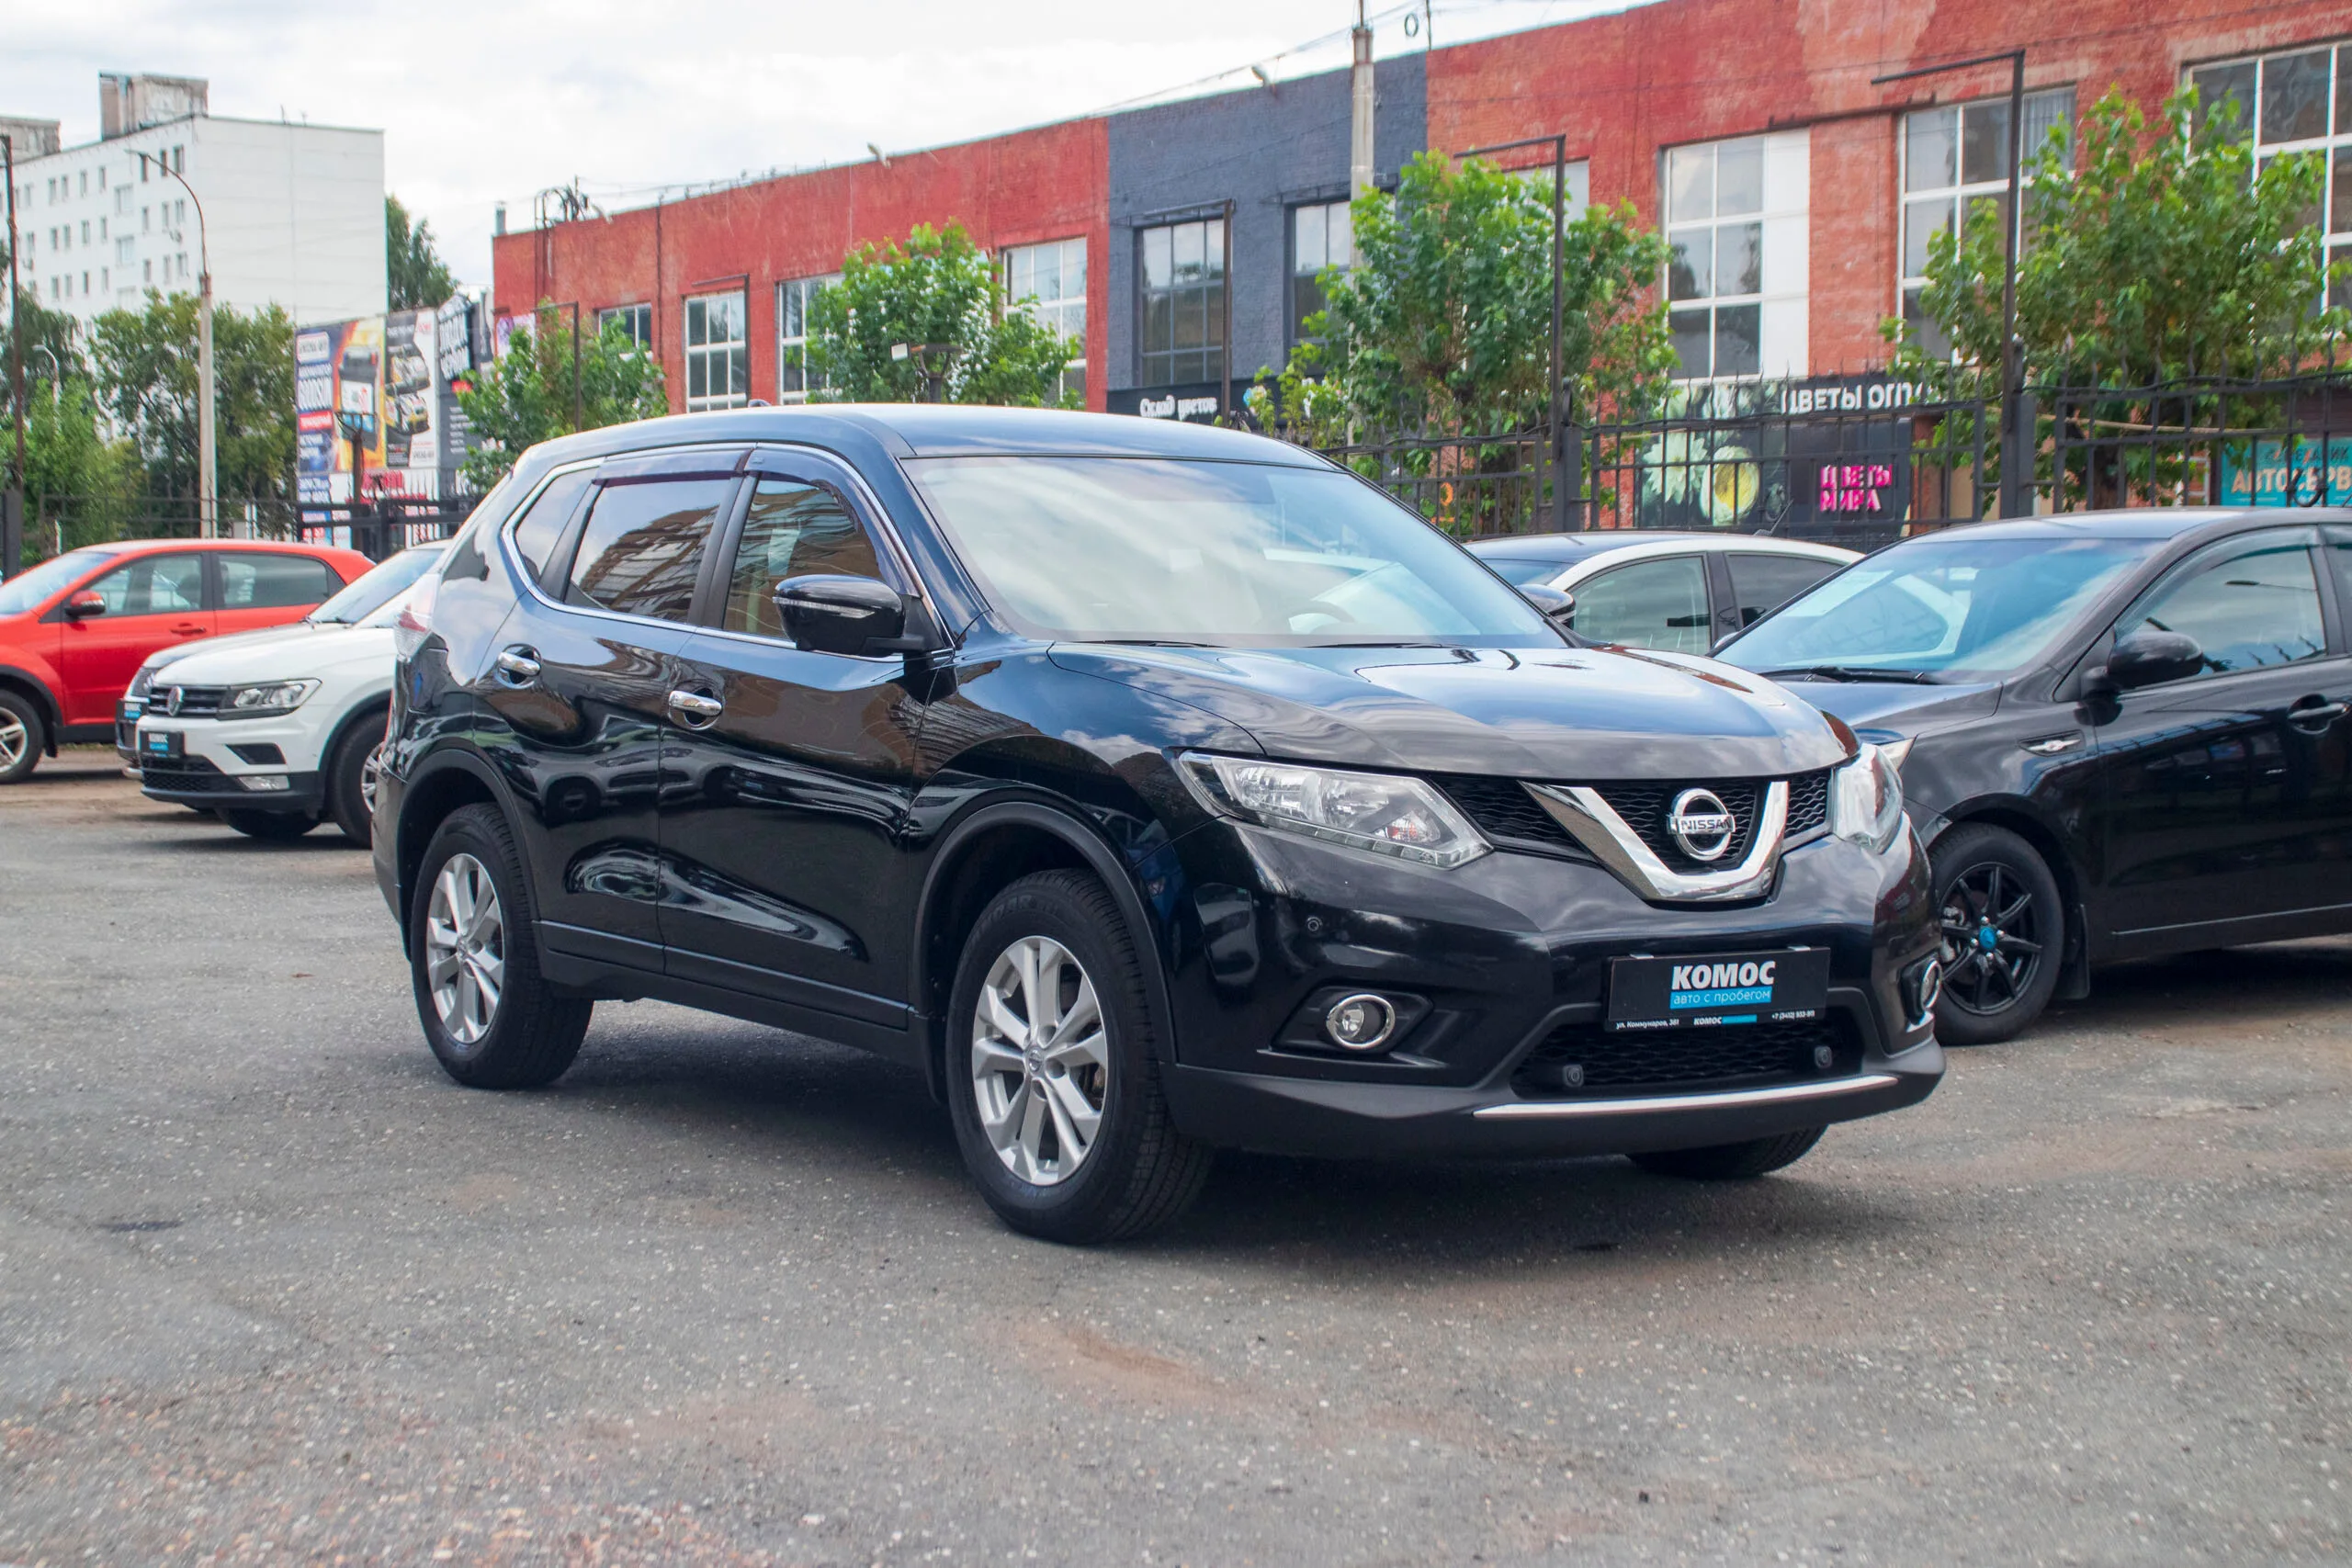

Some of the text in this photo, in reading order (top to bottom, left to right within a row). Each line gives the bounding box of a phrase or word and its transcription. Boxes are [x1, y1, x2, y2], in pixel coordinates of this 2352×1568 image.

[1140, 394, 1217, 422] Склад цветов
[1781, 384, 1862, 415] ЦВЕТЫ
[1820, 464, 1893, 491] ЦВЕТЫ
[1820, 489, 1882, 512] МИРА
[1680, 818, 1731, 830] NISSAN
[1672, 960, 1776, 990] КОМОС
[1673, 989, 1771, 1005] авто с пробегом
[1693, 1016, 1723, 1026] КОМОС
